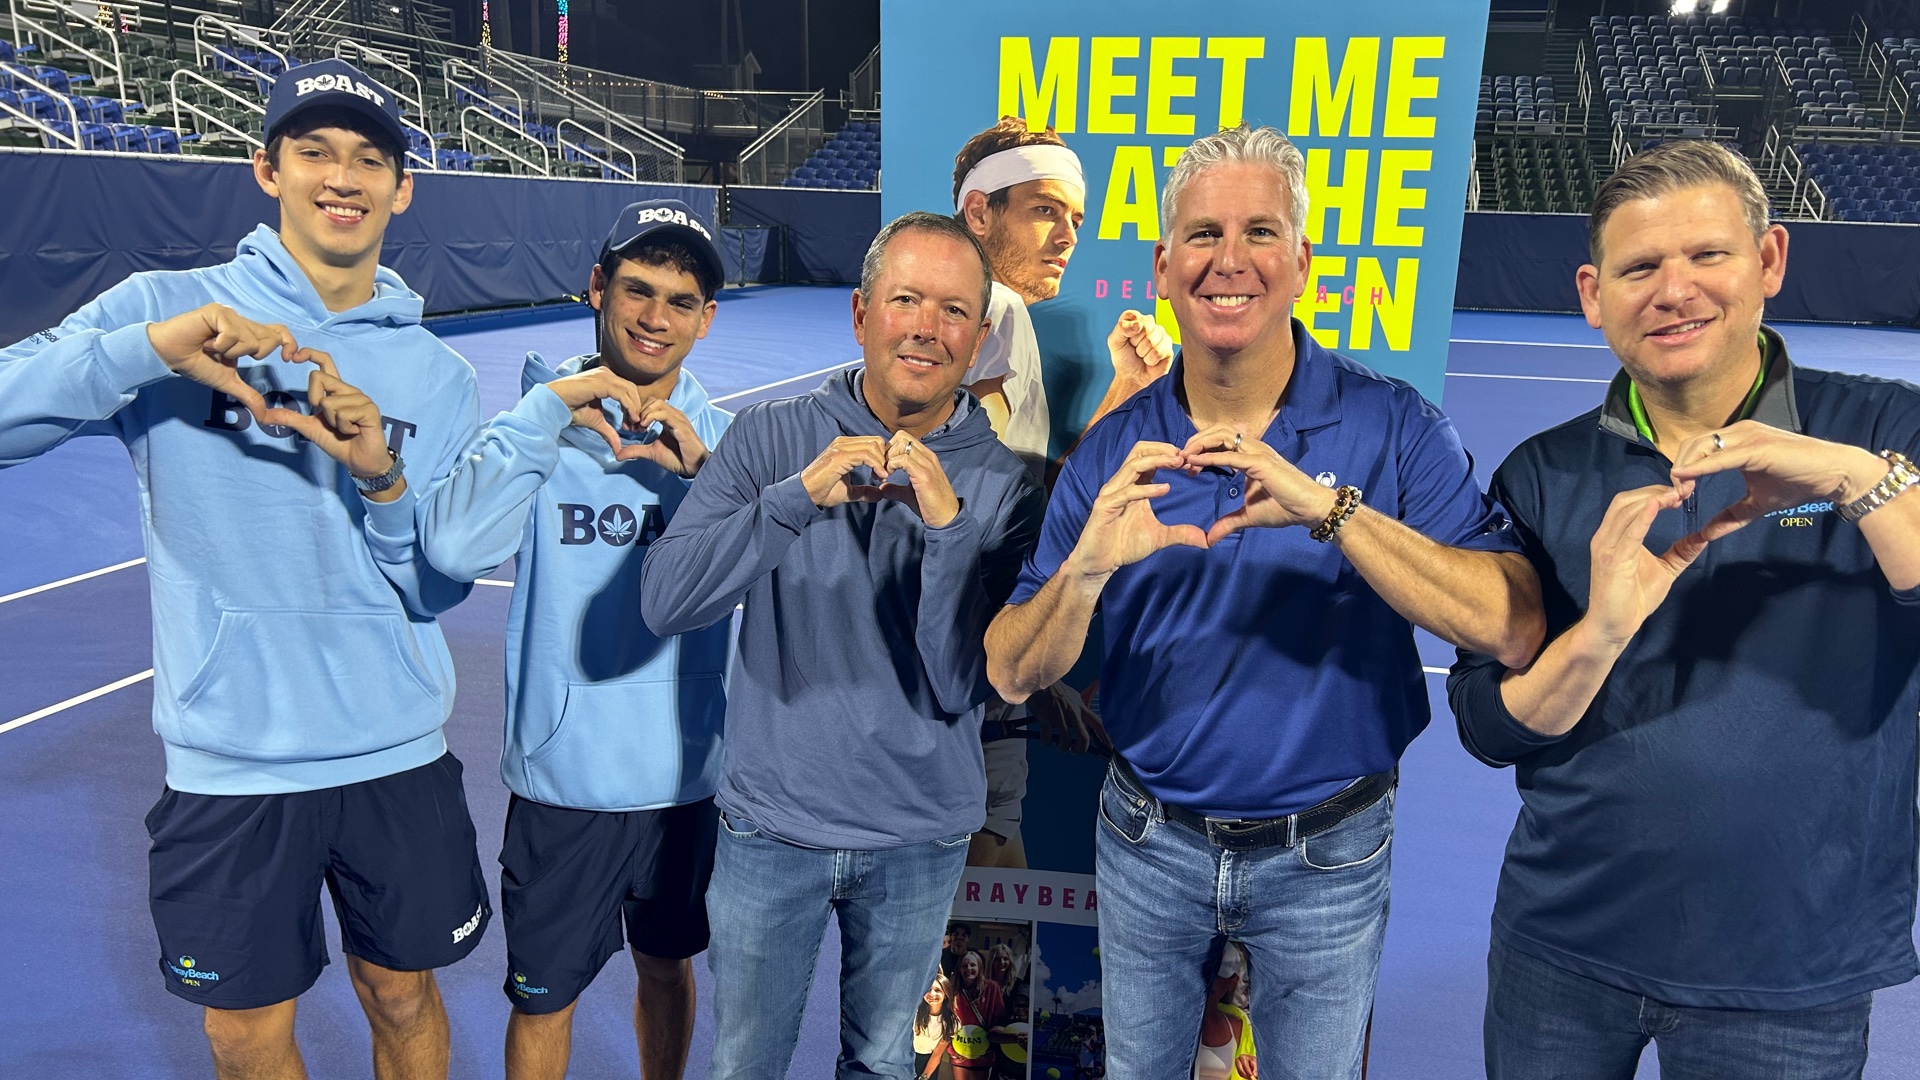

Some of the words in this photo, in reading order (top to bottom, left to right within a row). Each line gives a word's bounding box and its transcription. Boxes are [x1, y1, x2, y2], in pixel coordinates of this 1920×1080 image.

[295, 74, 385, 106] BOAST
[998, 37, 1264, 135] MEET
[1287, 37, 1446, 137] ME
[1097, 146, 1187, 241] A
[1305, 148, 1433, 246] HE
[557, 503, 667, 547] BOA
[1780, 517, 1813, 527] OPEN
